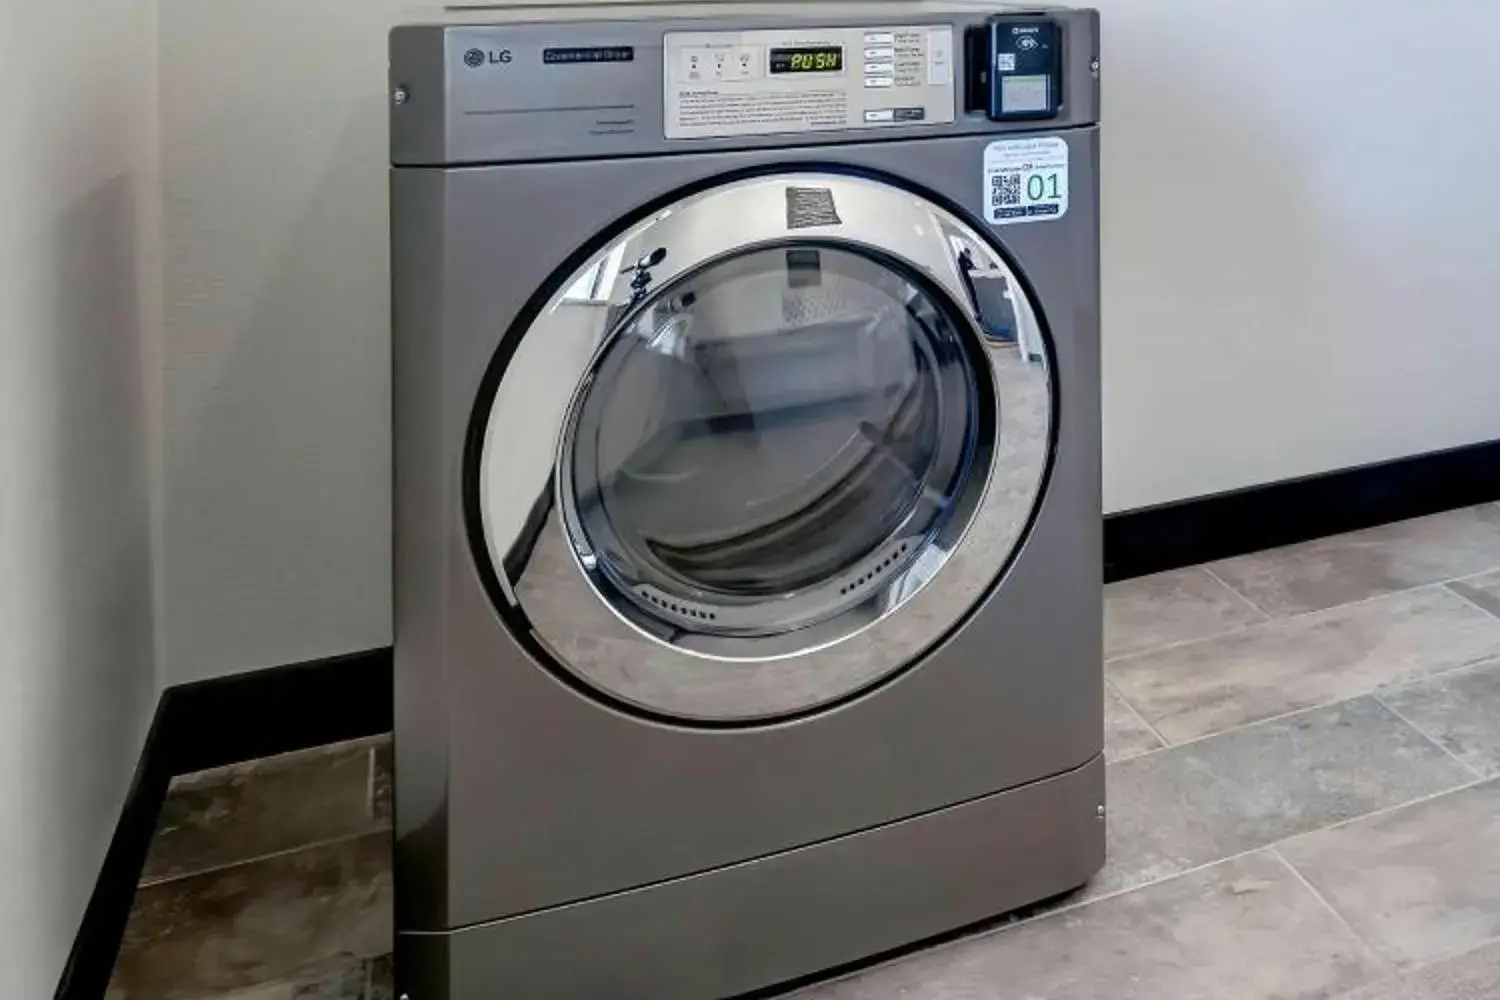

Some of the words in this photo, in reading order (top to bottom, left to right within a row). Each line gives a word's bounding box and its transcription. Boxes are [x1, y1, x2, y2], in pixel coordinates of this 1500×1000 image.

[489, 49, 513, 64] LG
[790, 52, 837, 69] PUSH
[1027, 173, 1062, 201] 01
